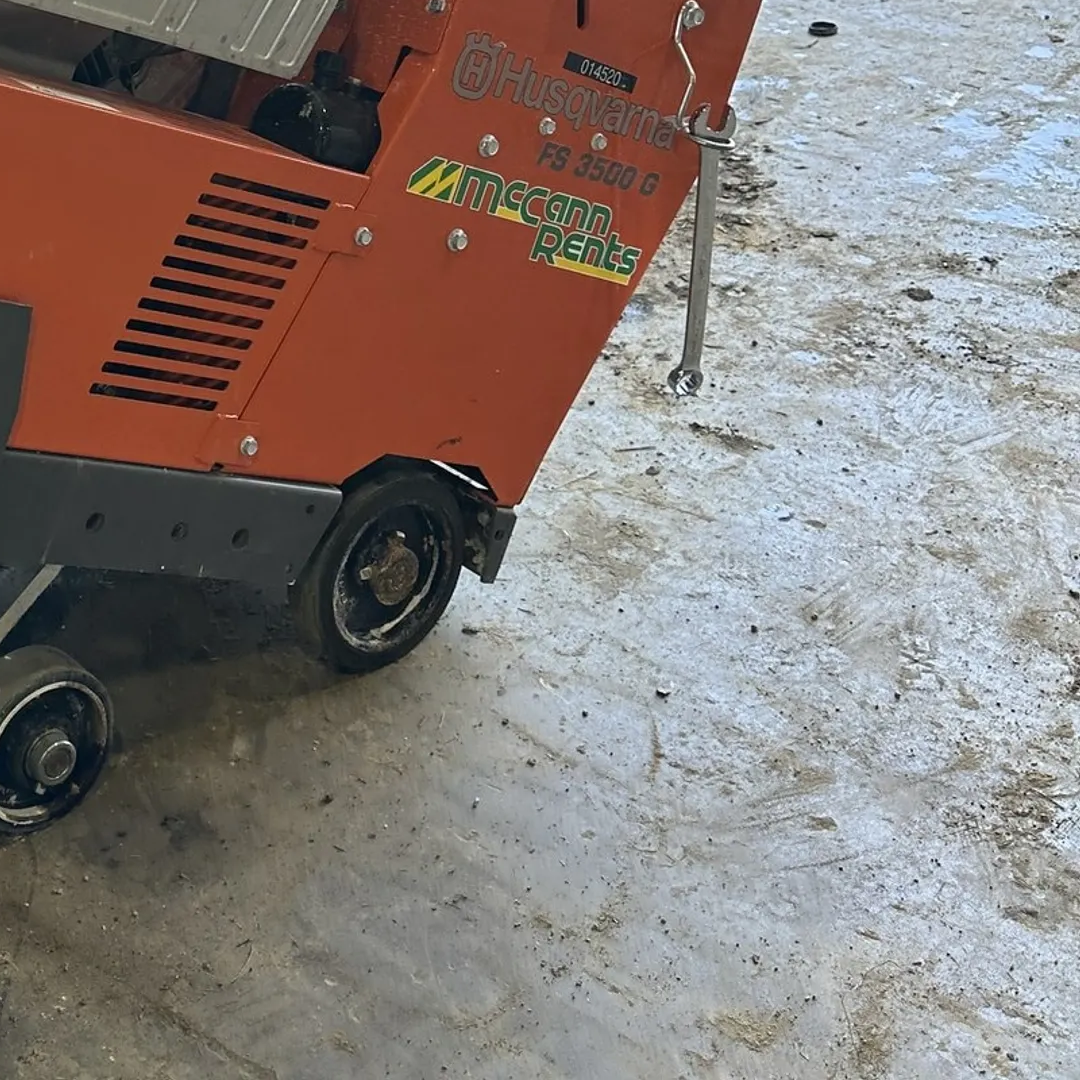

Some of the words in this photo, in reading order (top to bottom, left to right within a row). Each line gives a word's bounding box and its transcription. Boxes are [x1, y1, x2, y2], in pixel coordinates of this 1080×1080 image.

[581, 59, 621, 87] 014520
[493, 52, 676, 150] Husqvarna
[538, 142, 571, 171] FS
[574, 153, 638, 190] 3500
[639, 172, 659, 196] G
[530, 222, 642, 275] Rents
